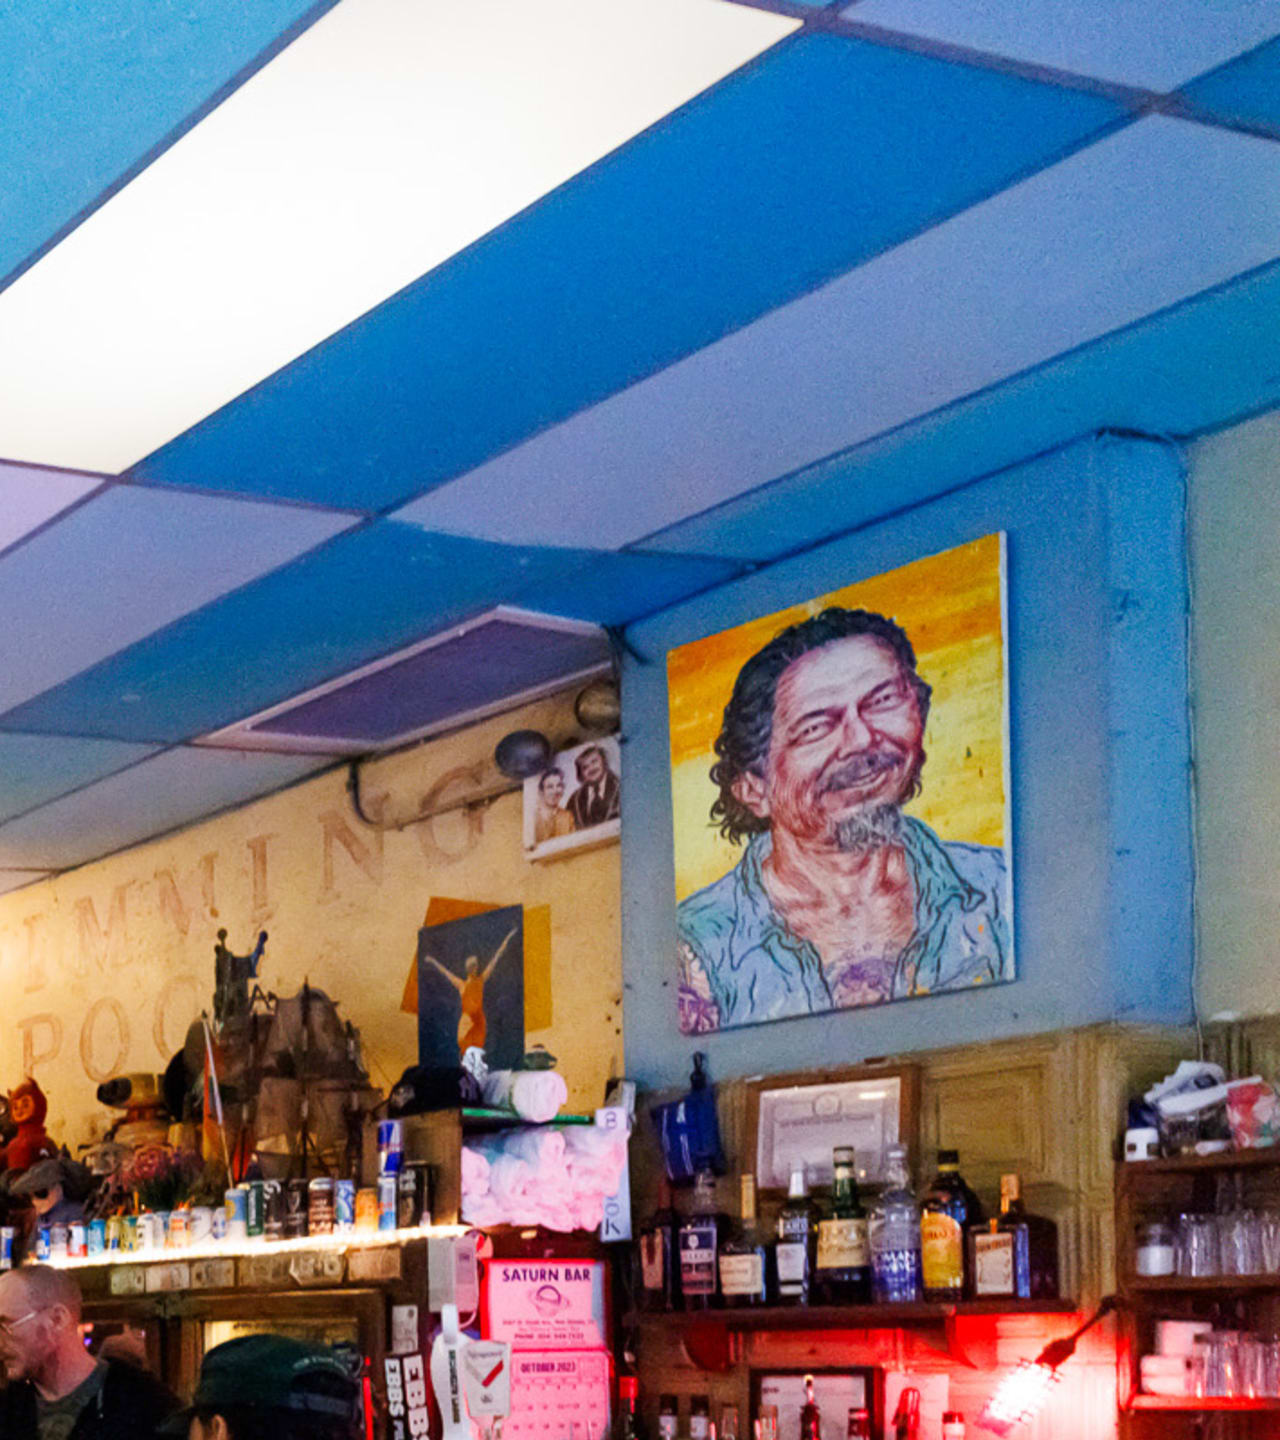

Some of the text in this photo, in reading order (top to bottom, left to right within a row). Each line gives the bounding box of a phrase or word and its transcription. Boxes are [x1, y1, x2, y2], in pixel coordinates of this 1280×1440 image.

[502, 1268, 591, 1282] SATURN BAR
[521, 1362, 555, 1373] OCTOBER
